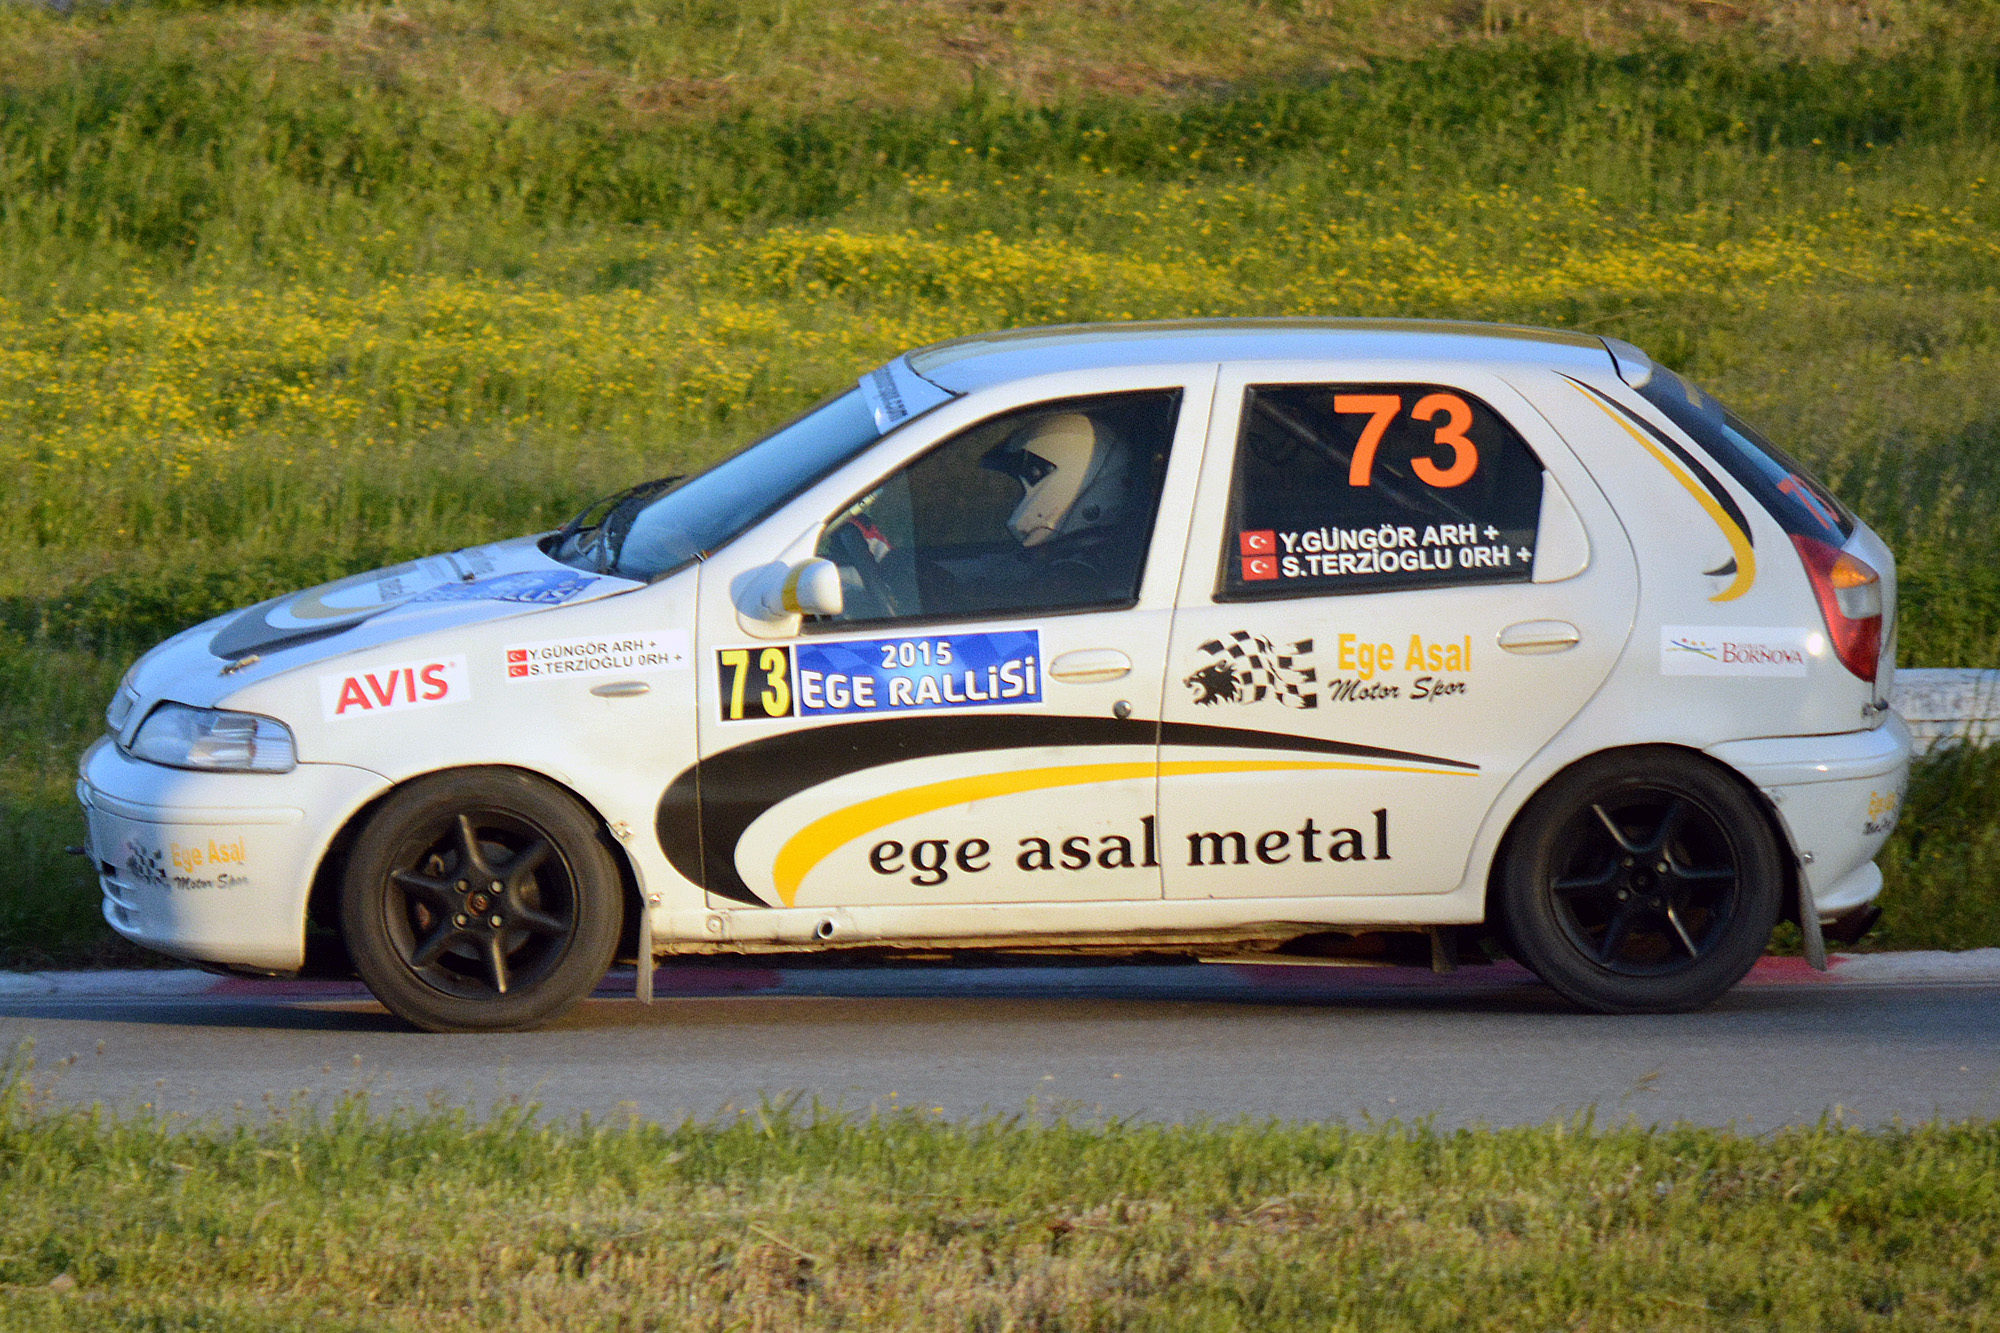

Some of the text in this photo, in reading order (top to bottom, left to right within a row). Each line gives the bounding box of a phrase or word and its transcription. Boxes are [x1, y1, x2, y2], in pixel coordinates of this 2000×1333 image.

[1333, 393, 1479, 488] 73
[1279, 524, 1417, 553] Y.GÜNGÖR
[1421, 524, 1477, 547] ARH
[528, 641, 607, 660] Y.GÜNGÖR
[611, 640, 644, 652] ARH
[881, 641, 951, 668] 2015
[1338, 633, 1471, 681] Ege Asal
[721, 648, 790, 719] 73
[800, 669, 876, 708] EGE
[1327, 676, 1466, 702] Motor Spor
[208, 836, 246, 864] Asal
[868, 808, 1392, 887] ege asal metal
